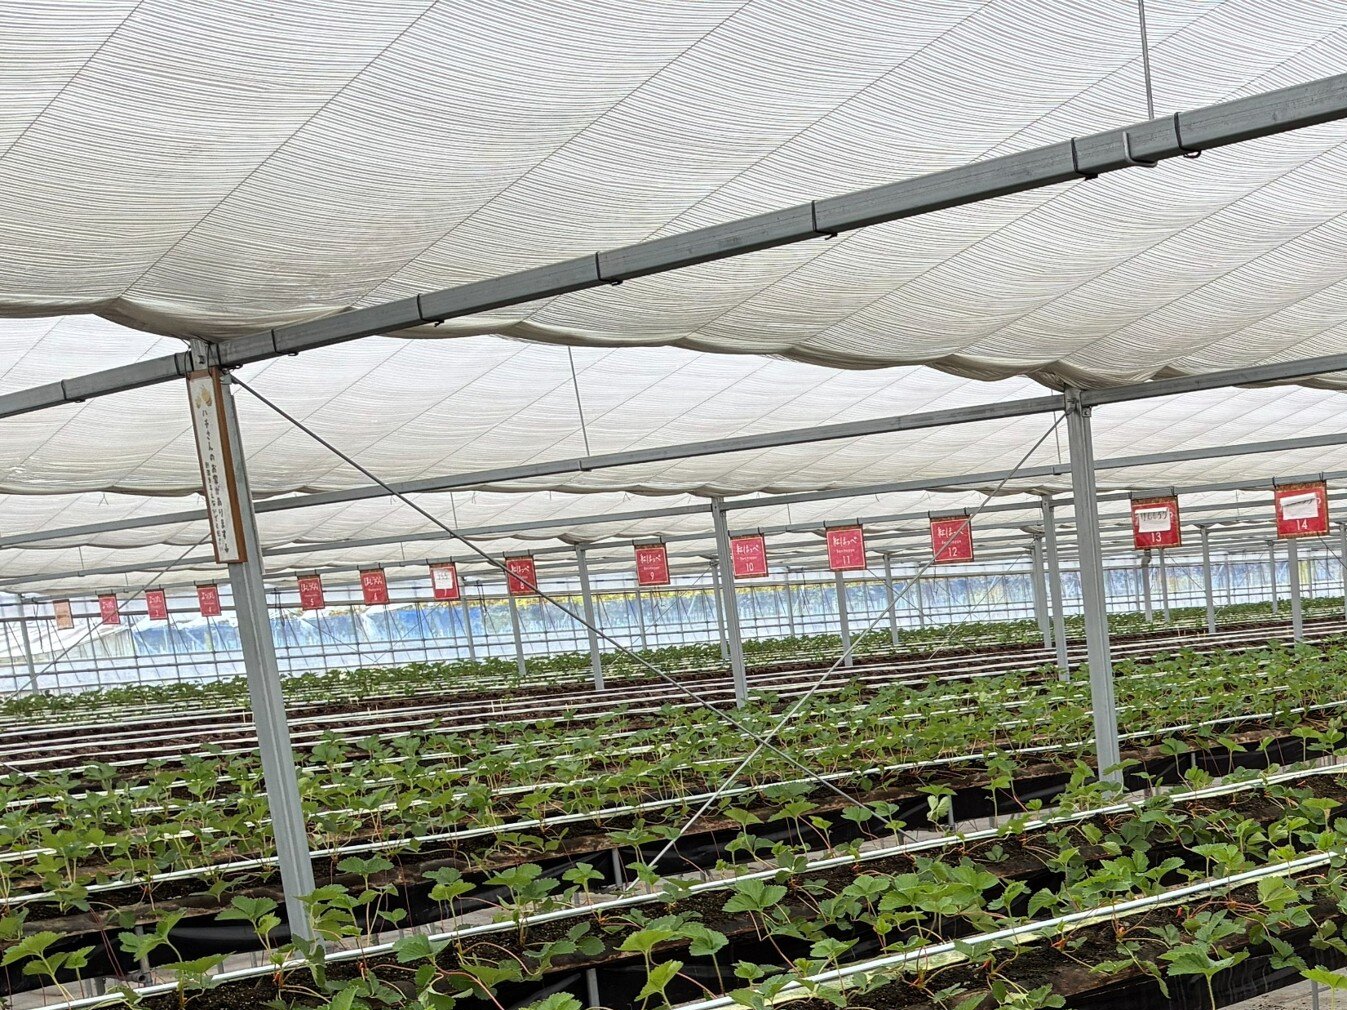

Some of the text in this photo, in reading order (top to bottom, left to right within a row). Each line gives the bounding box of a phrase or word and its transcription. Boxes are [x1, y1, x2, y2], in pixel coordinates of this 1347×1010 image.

[1296, 518, 1308, 531] 14
[1151, 532, 1162, 542] 13
[947, 546, 958, 557] 12
[842, 556, 851, 565] 11
[745, 562, 754, 572] 10
